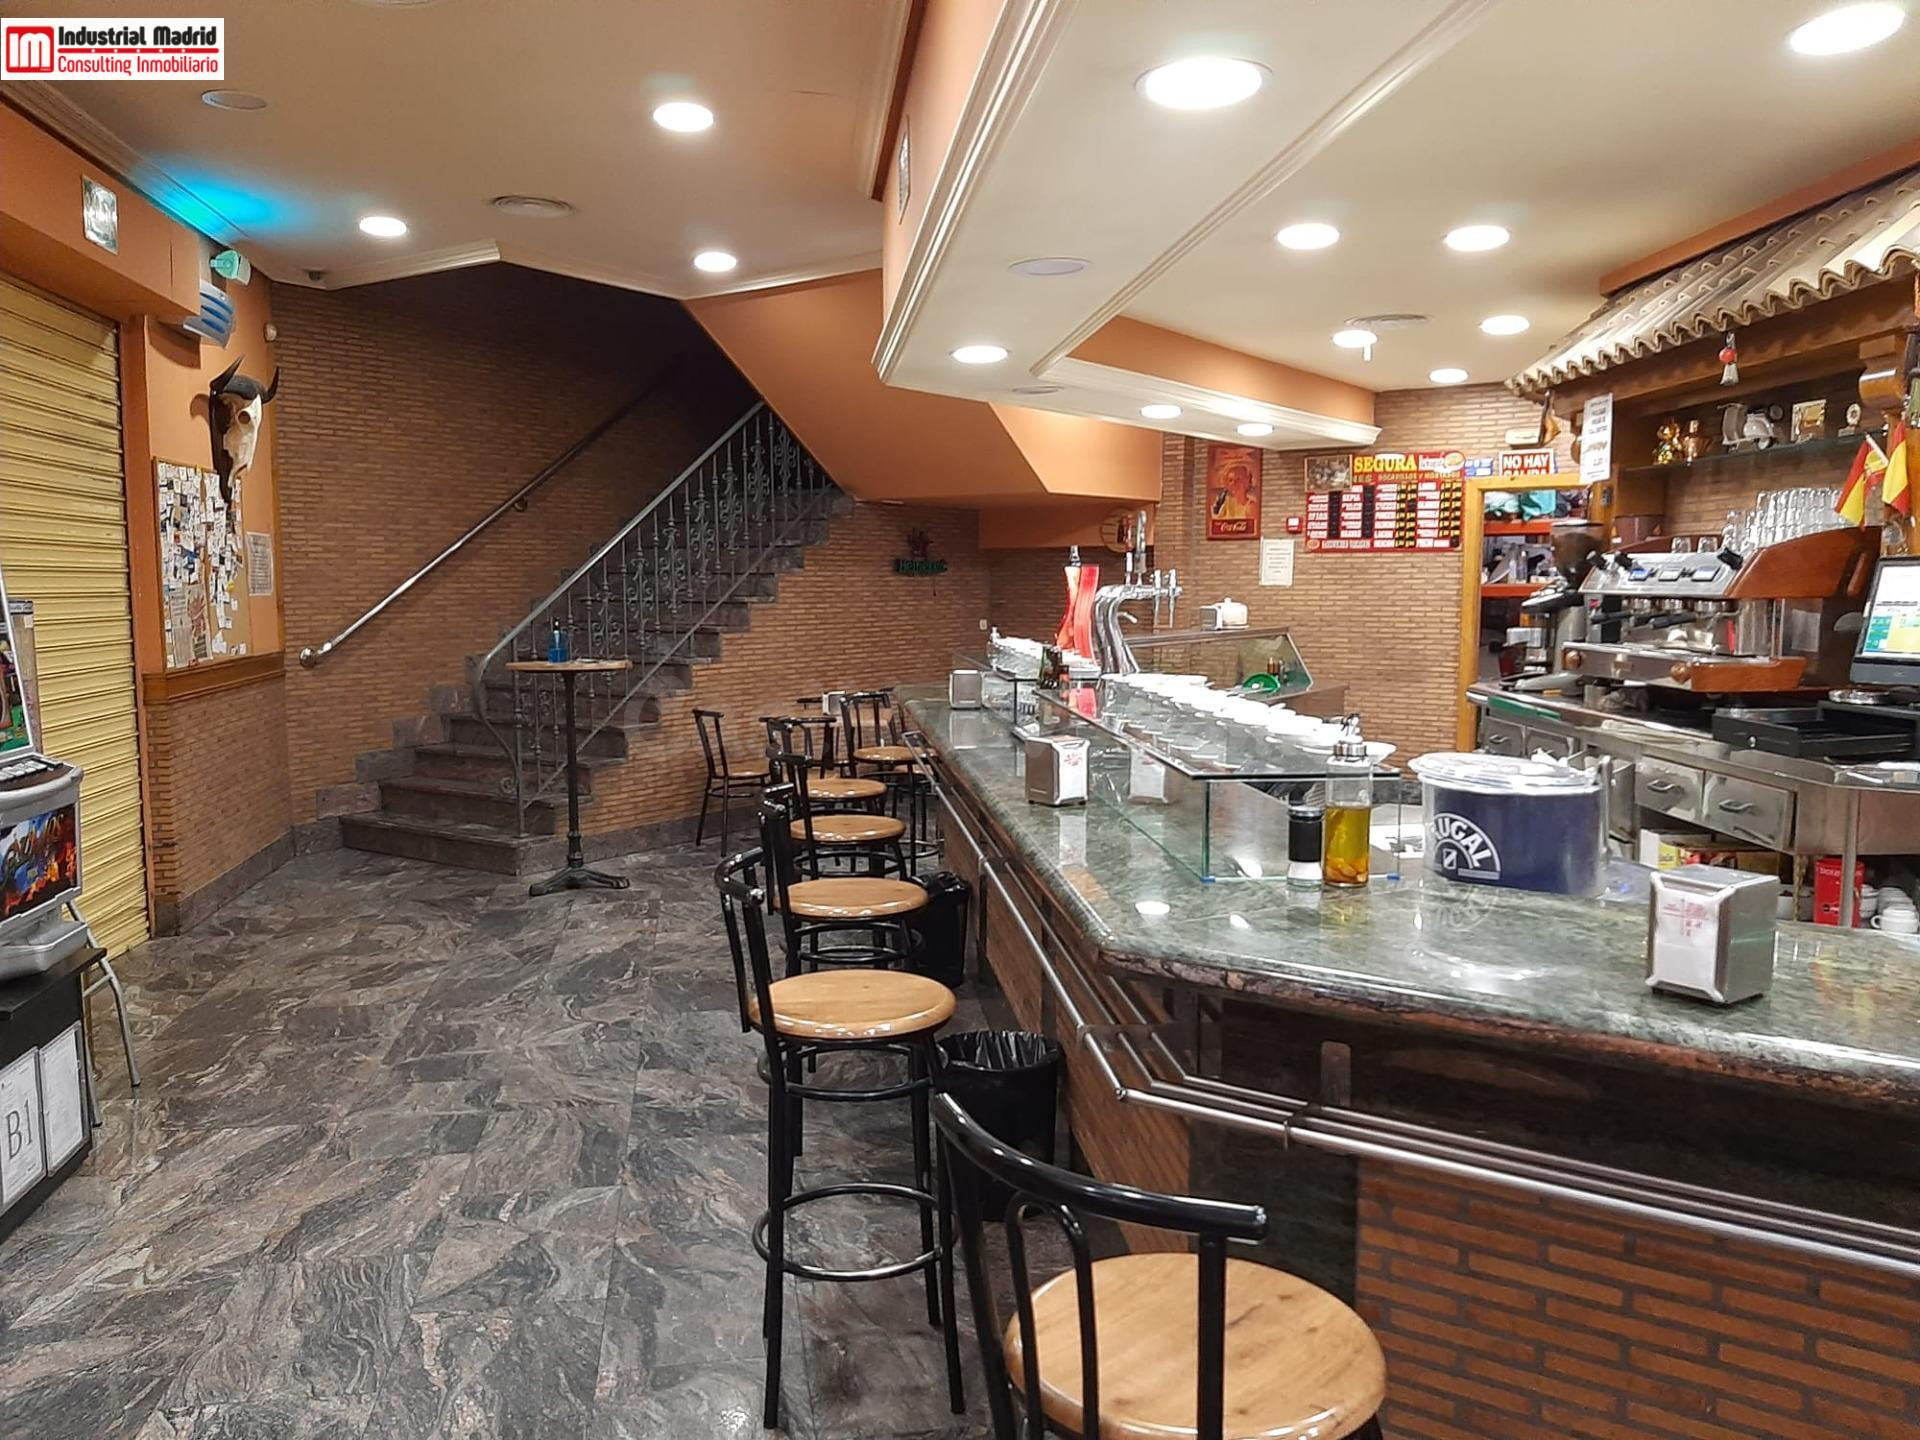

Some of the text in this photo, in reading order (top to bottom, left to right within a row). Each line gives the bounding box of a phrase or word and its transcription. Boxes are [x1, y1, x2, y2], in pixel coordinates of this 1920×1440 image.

[1354, 454, 1417, 473] SEGURA
[1503, 455, 1522, 469] NO
[1524, 454, 1549, 468] HAY
[5, 1098, 34, 1161] B1
